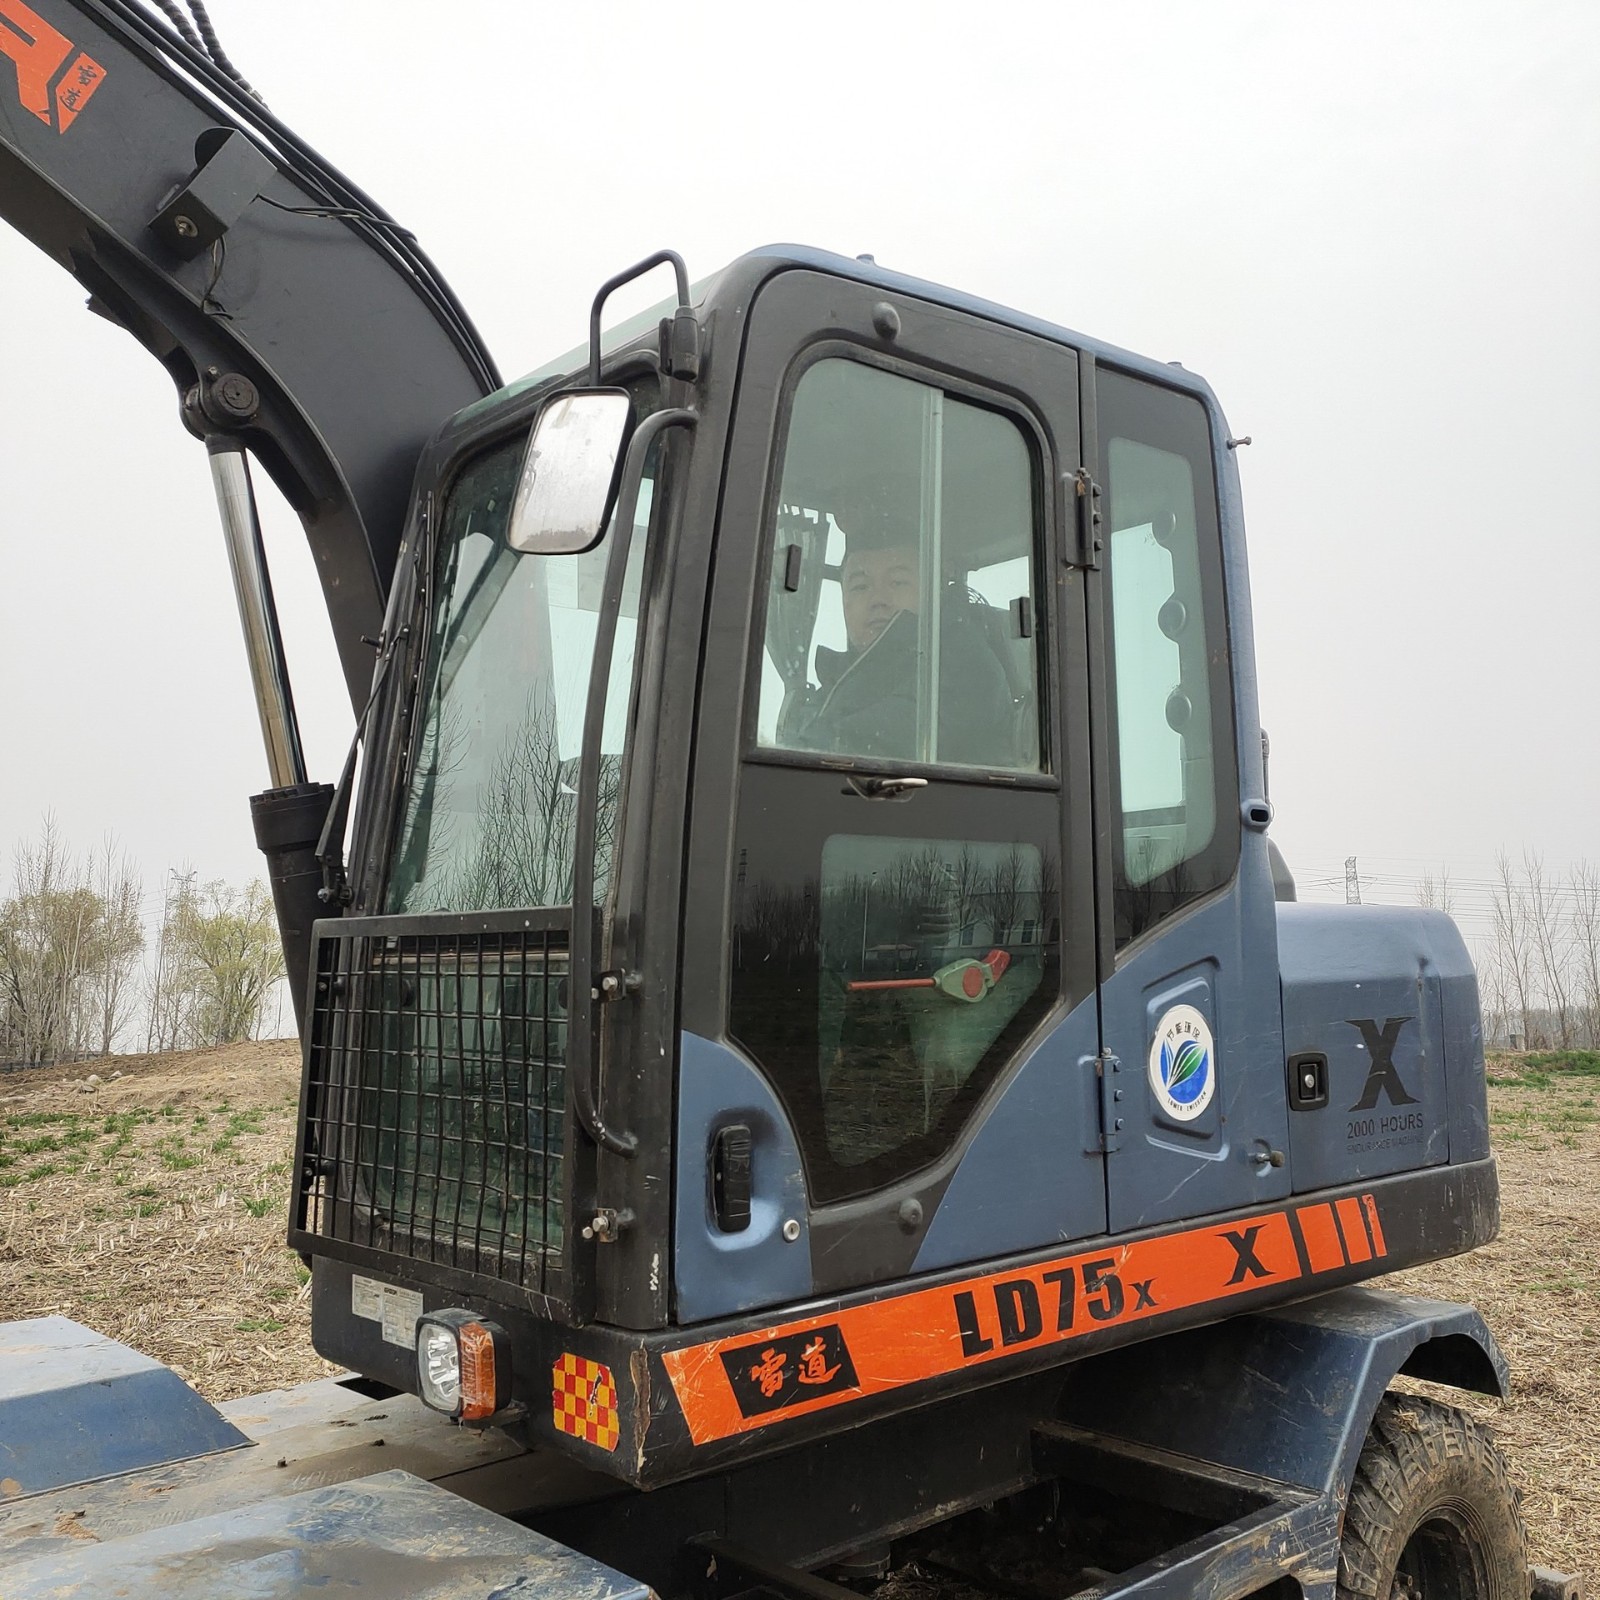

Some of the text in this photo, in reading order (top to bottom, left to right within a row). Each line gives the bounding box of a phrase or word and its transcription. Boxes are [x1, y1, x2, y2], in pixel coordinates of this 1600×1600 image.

[1345, 1017, 1421, 1112] X
[1347, 1112, 1424, 1139] 2000 HOURS
[1214, 1223, 1277, 1286] X
[751, 1336, 842, 1397] 雷道
